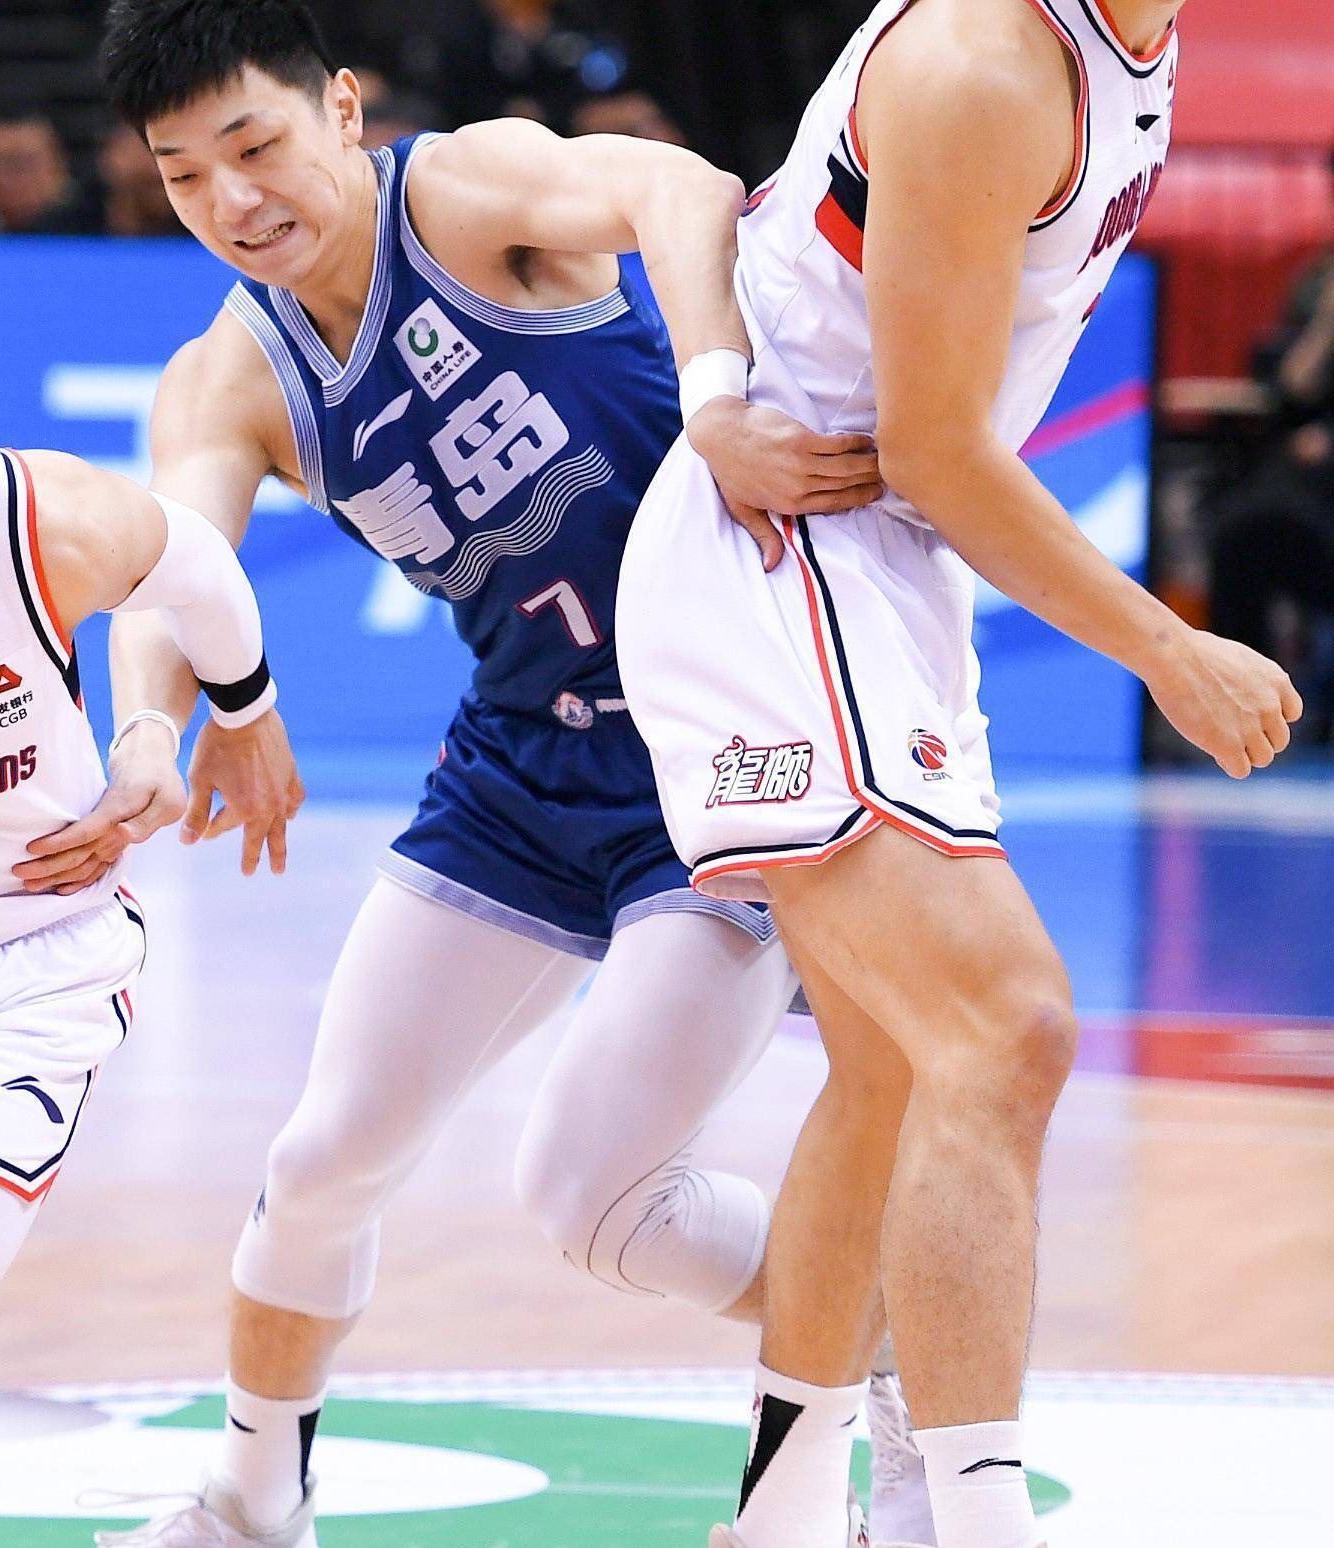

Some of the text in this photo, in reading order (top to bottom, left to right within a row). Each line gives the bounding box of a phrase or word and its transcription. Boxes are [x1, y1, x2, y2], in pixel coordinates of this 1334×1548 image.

[422, 341, 464, 383] 中国人寿
[430, 350, 472, 390] CHINA LIFE
[329, 370, 570, 565] 青岛
[515, 577, 602, 648] 7
[0, 708, 28, 728] CGB
